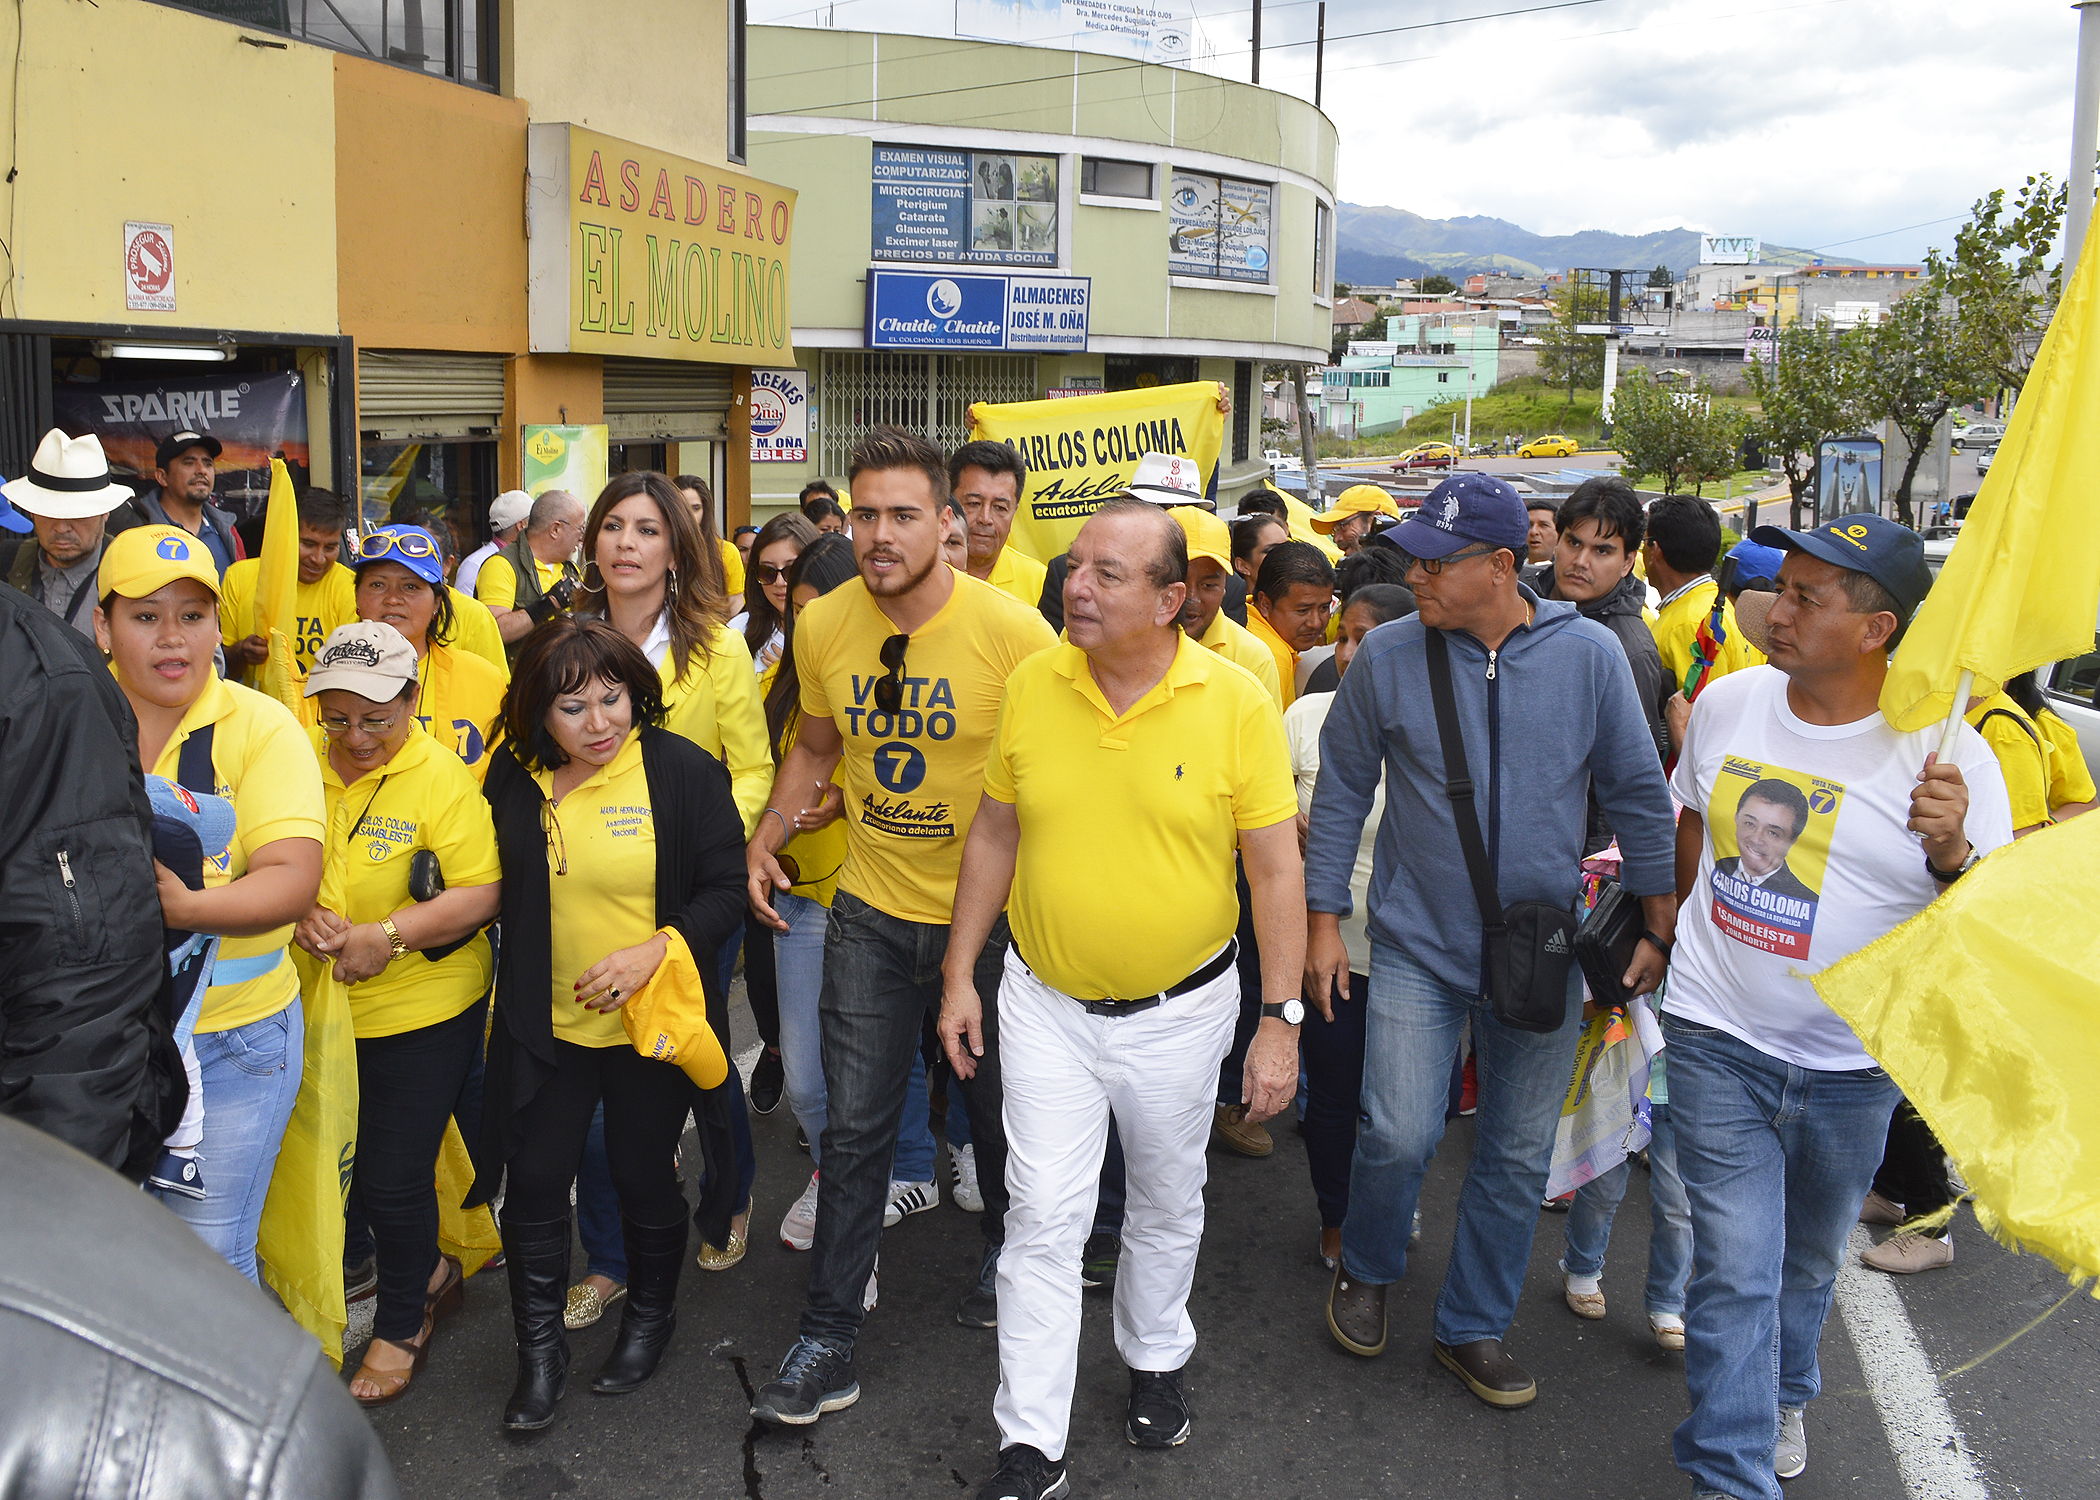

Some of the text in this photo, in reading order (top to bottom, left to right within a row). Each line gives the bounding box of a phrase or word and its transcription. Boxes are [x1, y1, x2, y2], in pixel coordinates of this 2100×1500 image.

[1076, 8, 1090, 17] Dra.
[1091, 11, 1123, 22] Mercedes
[1137, 7, 1145, 16] DE
[1145, 8, 1156, 17] LOS
[1157, 11, 1172, 19] OJOS
[880, 151, 965, 165] EXAMEN VISUAL
[874, 165, 970, 179] COMPUTARIZADO
[579, 150, 789, 245] ASADERO
[879, 185, 965, 199] MICROCIRUGIA:
[896, 200, 948, 212] Pterigium
[899, 212, 946, 223] Catarata
[895, 224, 949, 235] Glaucoma
[131, 232, 154, 270] PROSEGUR
[885, 236, 959, 248] Excimer laser
[1706, 238, 1753, 252] VIVE
[874, 249, 1052, 263] PRECIOS DE AYUDA SOCIAL
[579, 222, 786, 349] EL MOLINO
[1012, 287, 1085, 305] ALMACENES
[879, 317, 937, 333] Chaide
[943, 319, 1001, 335] Chaide
[1011, 309, 1085, 330] JOSÉ M. OÑA
[962, 337, 992, 345] SUEÑOS
[1011, 333, 1084, 343] Distribuidor Autorizado
[751, 372, 804, 405] ACENES
[100, 387, 241, 430] SPARKLE
[776, 436, 803, 448] OÑA
[1093, 417, 1187, 465] COLOMA
[751, 449, 804, 460] EBLES
[1032, 473, 1131, 501] Adela
[1035, 502, 1105, 518] ecuatorian
[1436, 520, 1453, 531] USPA
[164, 540, 182, 558] 7
[296, 617, 324, 636] TA
[296, 637, 324, 656] DO
[851, 674, 957, 709] VTA
[845, 706, 957, 741] TODO
[455, 725, 471, 757] 7
[887, 750, 912, 784] 7
[1811, 778, 1844, 793] VOTA TODO
[862, 792, 951, 822] Adelante
[1814, 791, 1834, 812] 7
[362, 815, 417, 833] ARLOS COLOMA
[908, 825, 951, 836] adelante
[375, 848, 383, 859] 7
[1712, 870, 1811, 920] CARLOS COLOMA
[1726, 925, 1742, 940] ZONA
[1743, 935, 1769, 950] NORTE
[1544, 941, 1570, 955] adidas
